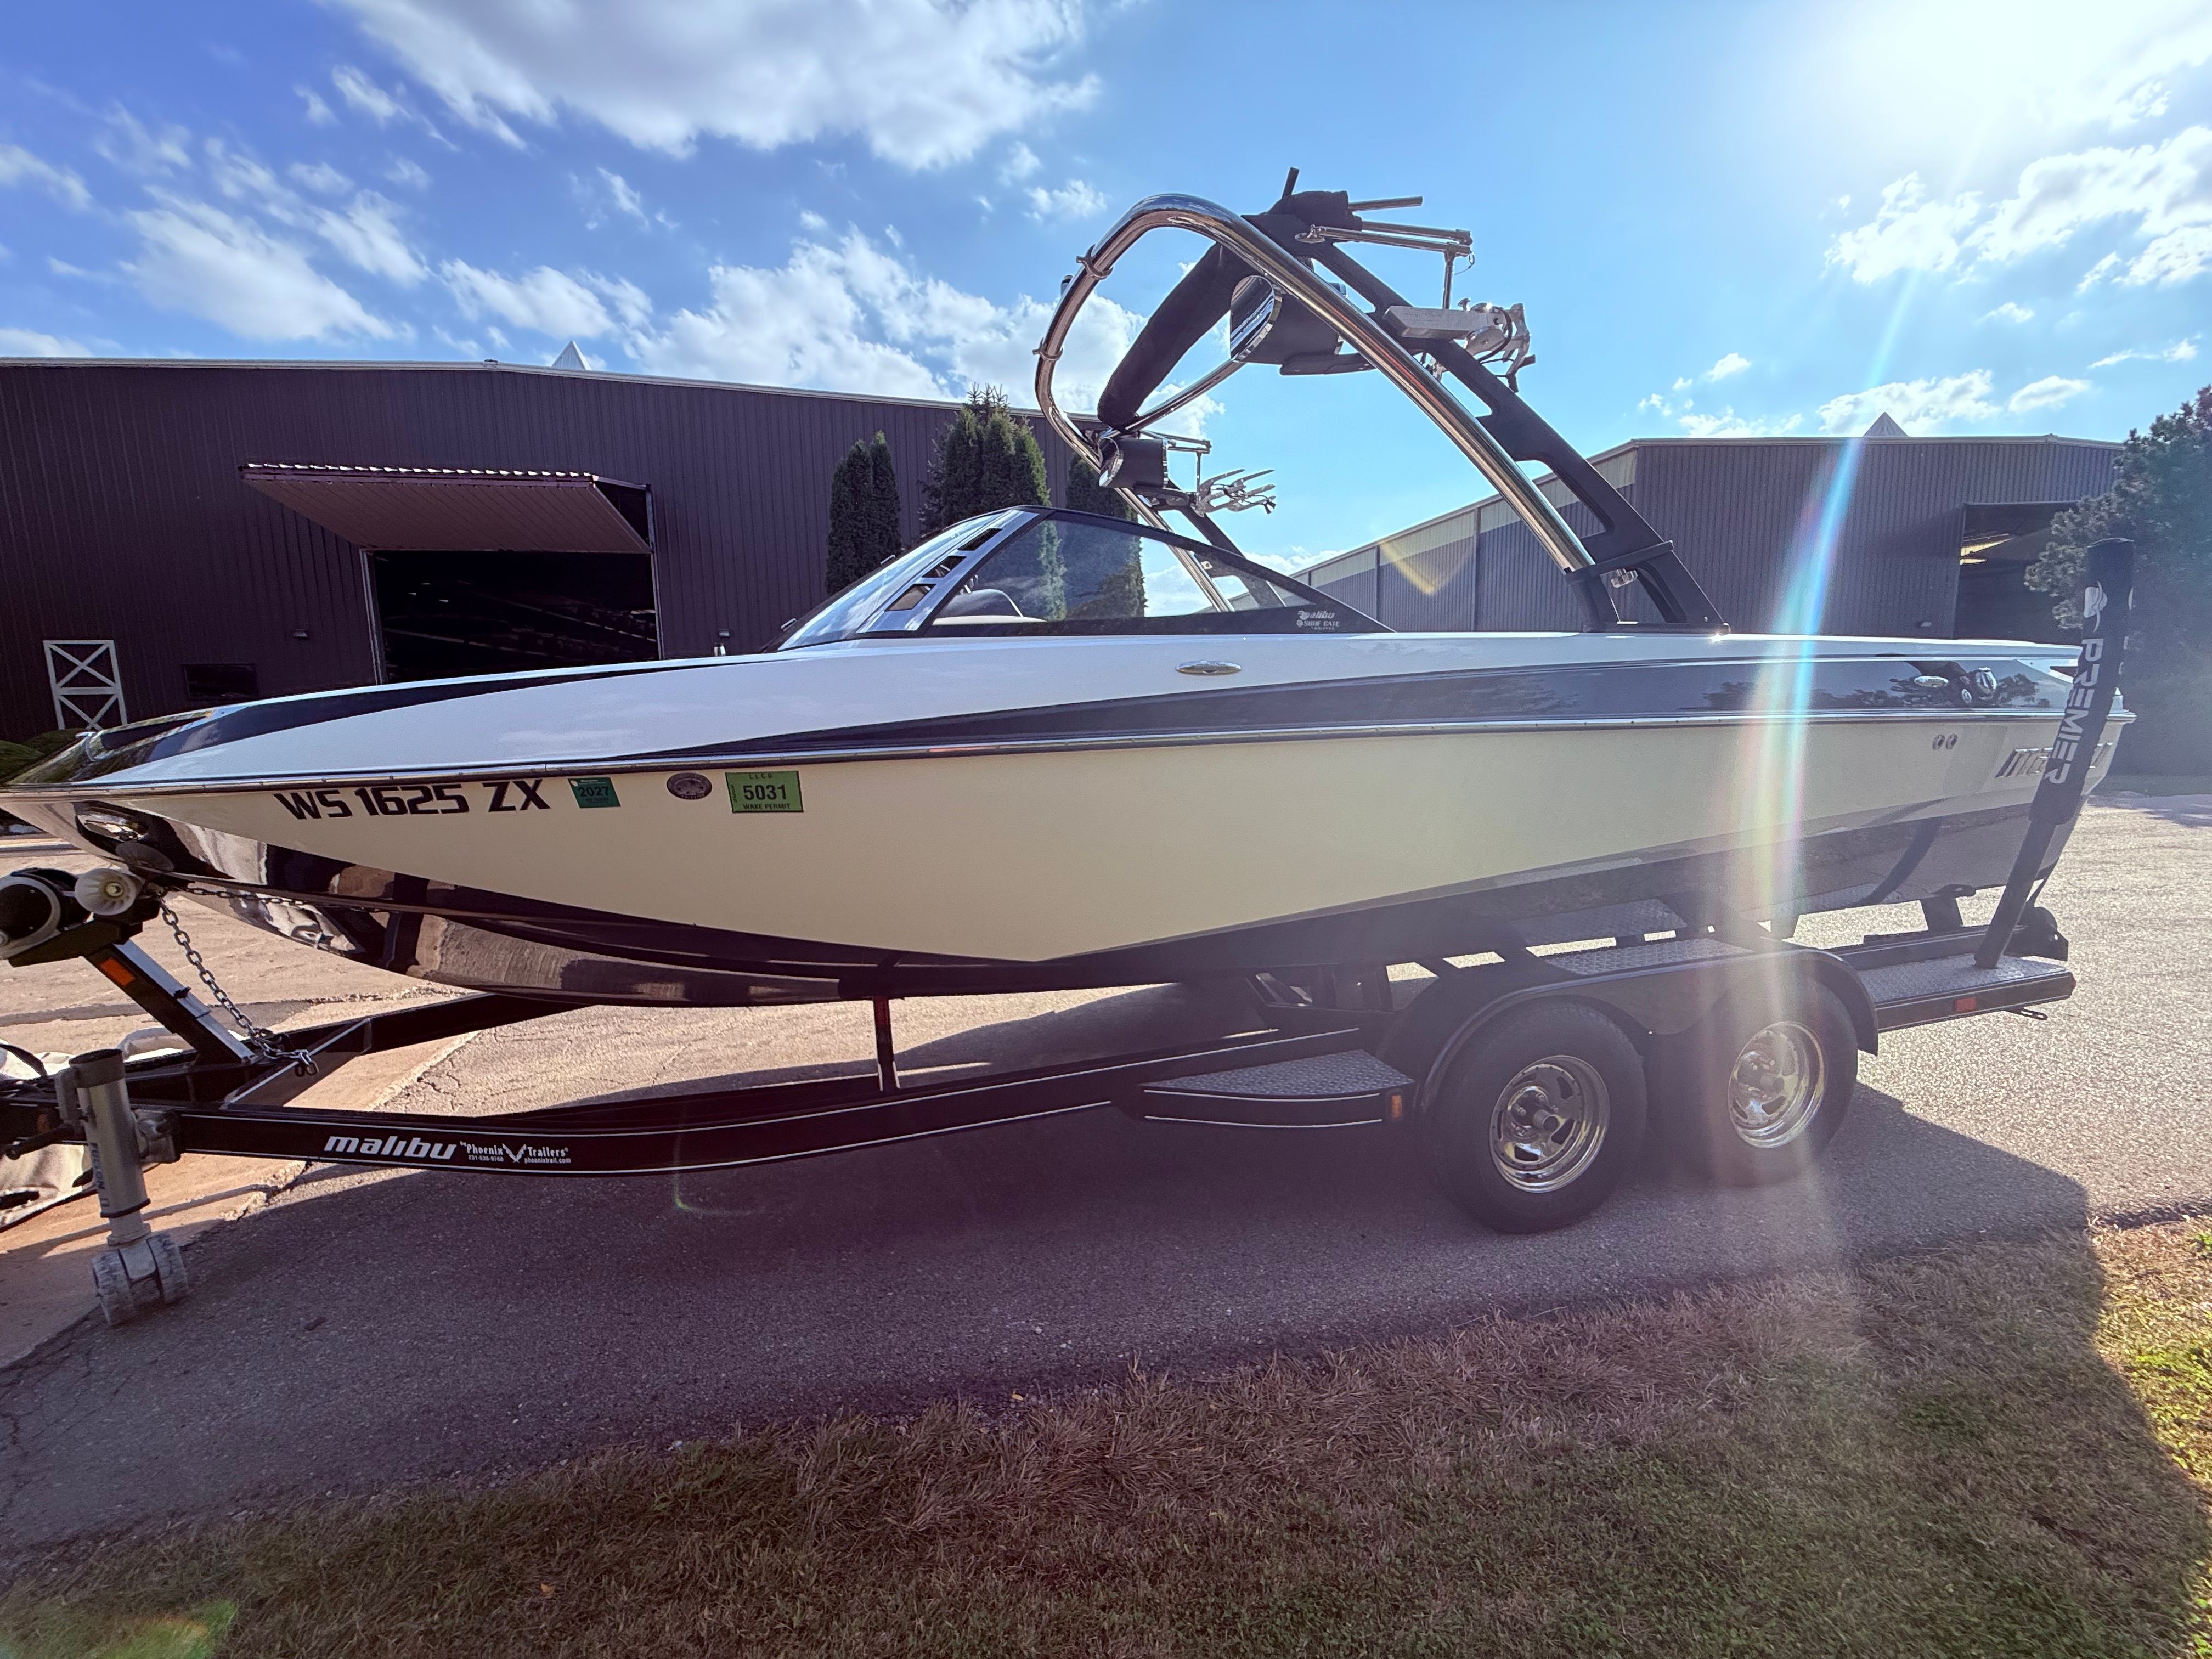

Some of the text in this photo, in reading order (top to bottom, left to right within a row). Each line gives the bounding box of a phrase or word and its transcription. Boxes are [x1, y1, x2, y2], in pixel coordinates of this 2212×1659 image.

[2044, 638, 2104, 785] PREMIER
[274, 779, 551, 820] WS 1625 ZX
[578, 786, 609, 796] 2027
[743, 784, 787, 800] 5031
[324, 1135, 457, 1160] malibu
[466, 1144, 504, 1155] Phoenix
